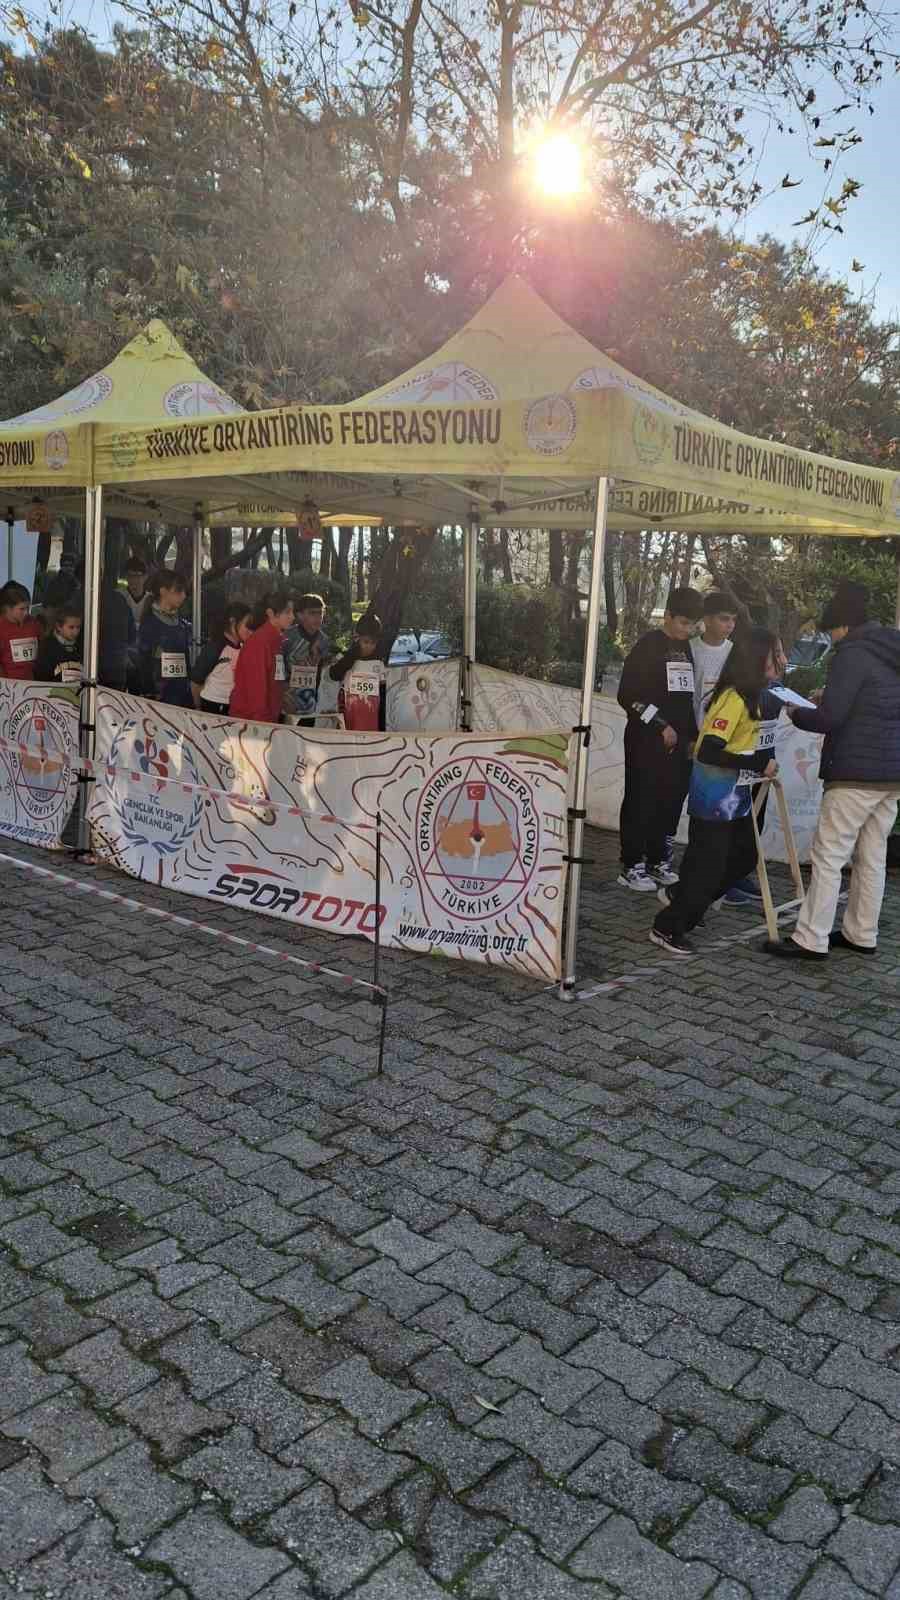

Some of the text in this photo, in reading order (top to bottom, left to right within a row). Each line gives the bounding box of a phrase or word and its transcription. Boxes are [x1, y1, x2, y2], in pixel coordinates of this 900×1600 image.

[145, 424, 210, 459] TÜRKİYE
[213, 407, 333, 452] ORYANTİRİNG
[339, 408, 500, 445] FEDERASYONU
[674, 421, 885, 508] TÜRKİYE ORYANTİRİNG FEDERASYONU
[357, 682, 374, 692] 559
[678, 676, 688, 687] 15
[421, 763, 537, 867] ORYANTİRİNG FEDERASYONU
[460, 879, 486, 890] 2002
[441, 888, 502, 914] TÜRKİYE
[399, 923, 529, 956] www.oryantiring.org.tr
